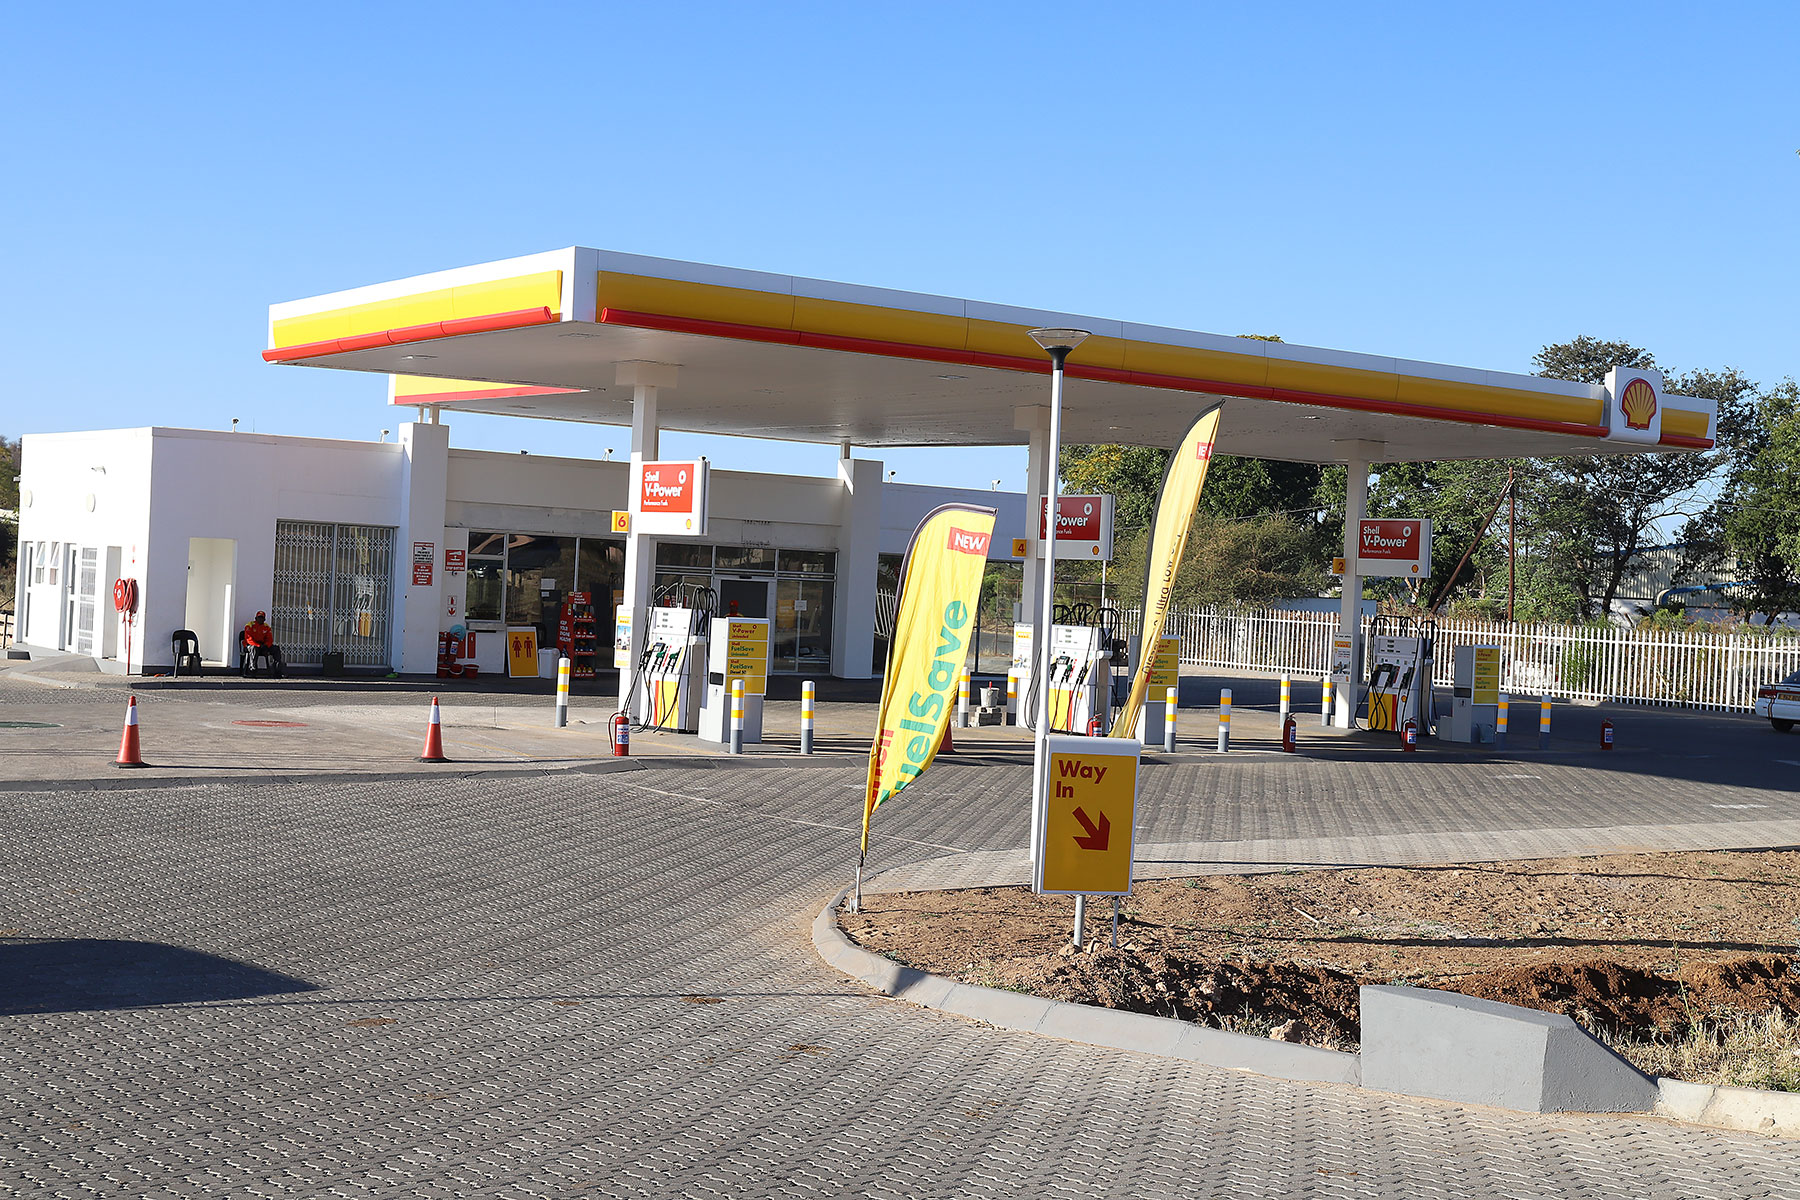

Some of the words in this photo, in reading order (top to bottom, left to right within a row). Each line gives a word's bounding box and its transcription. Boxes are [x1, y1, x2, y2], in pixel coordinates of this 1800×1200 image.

[644, 471, 660, 481] Shell
[644, 482, 683, 497] V-Power
[618, 516, 626, 527] 6
[1363, 526, 1380, 535] Shell
[954, 532, 985, 550] NEW
[1363, 535, 1408, 547] V-Power
[1018, 544, 1025, 553] 4
[1338, 562, 1344, 571] 2
[1058, 760, 1108, 784] Way
[1056, 781, 1074, 798] In
